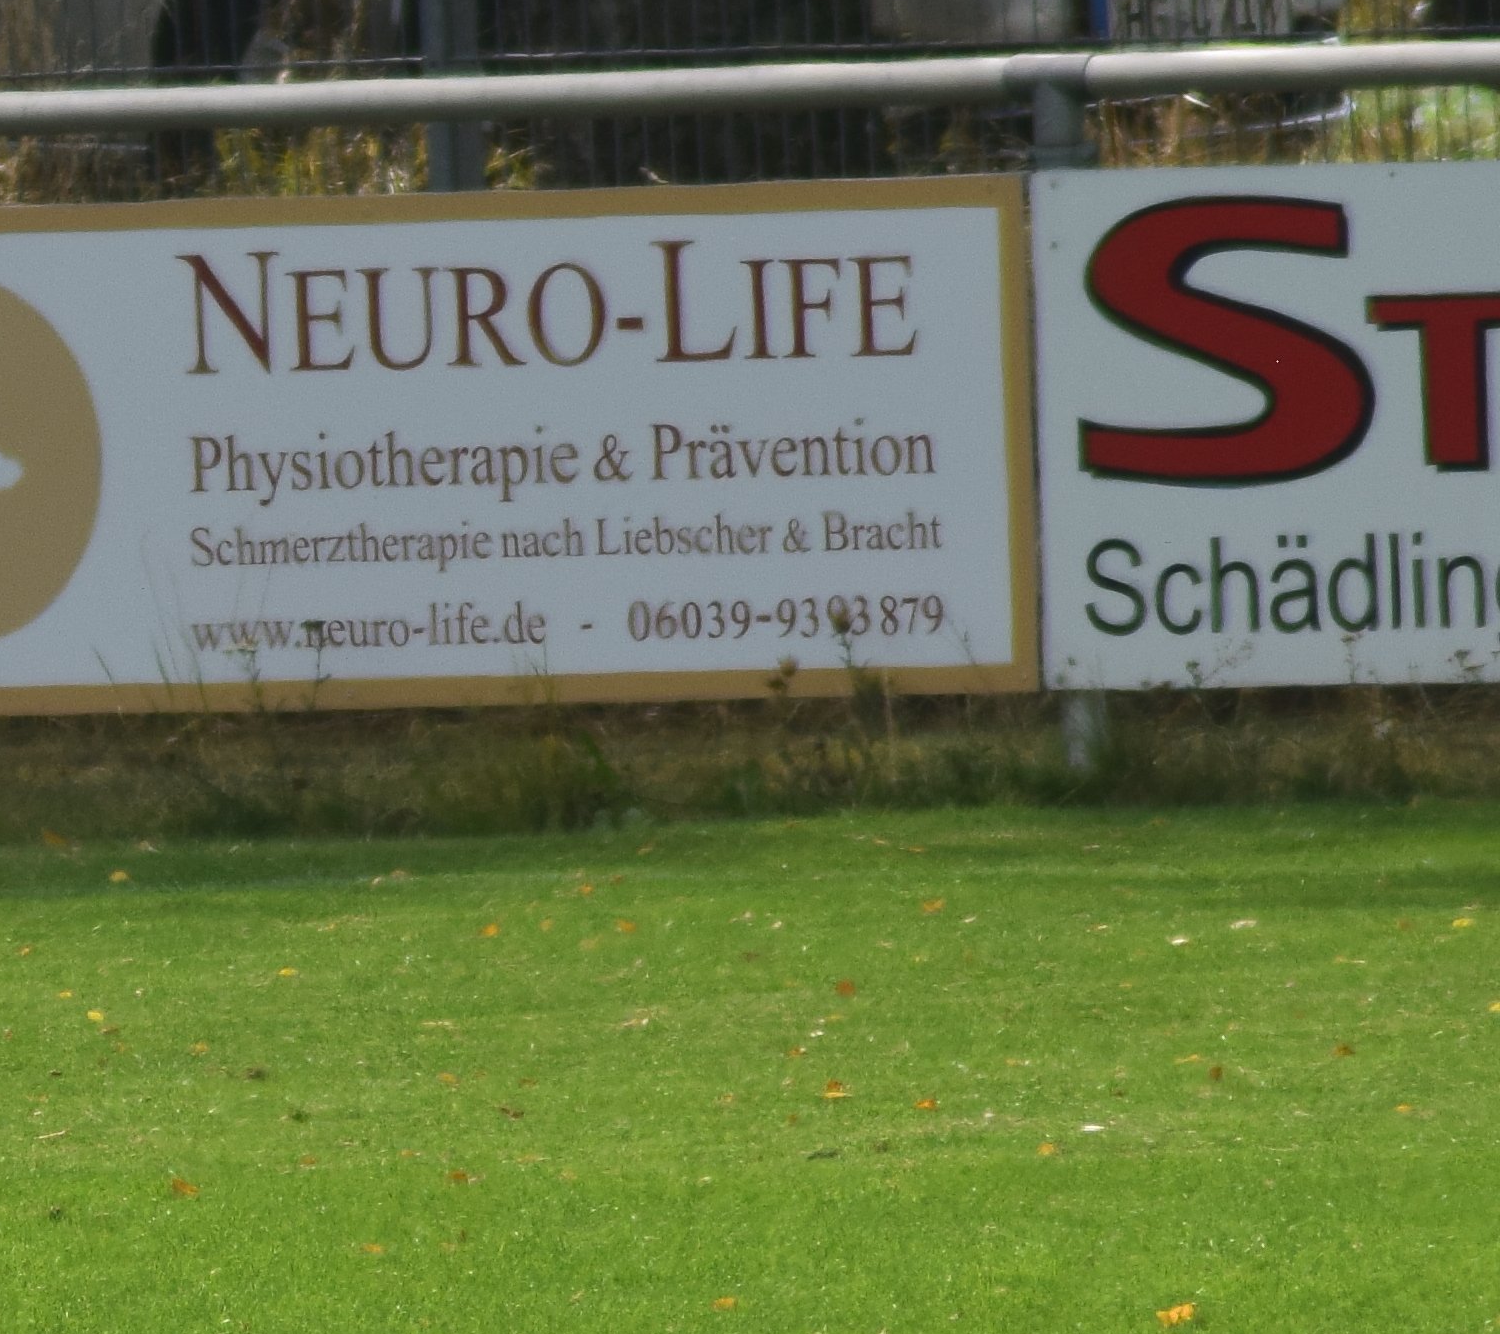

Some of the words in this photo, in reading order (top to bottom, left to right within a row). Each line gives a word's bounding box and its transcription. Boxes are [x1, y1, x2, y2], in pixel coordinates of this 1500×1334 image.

[176, 240, 918, 373] NEURO-LIFE
[190, 425, 578, 508] Physiotherapie
[594, 434, 632, 480] &
[651, 418, 937, 483] Prävention
[190, 521, 492, 572] Schmerztherapie
[502, 518, 584, 559] nach
[596, 514, 773, 558] Liebscher
[782, 516, 810, 555] &
[823, 511, 943, 553] Bracht
[1085, 532, 1500, 637] Schädlin
[191, 600, 547, 652] www.neuro-life.de
